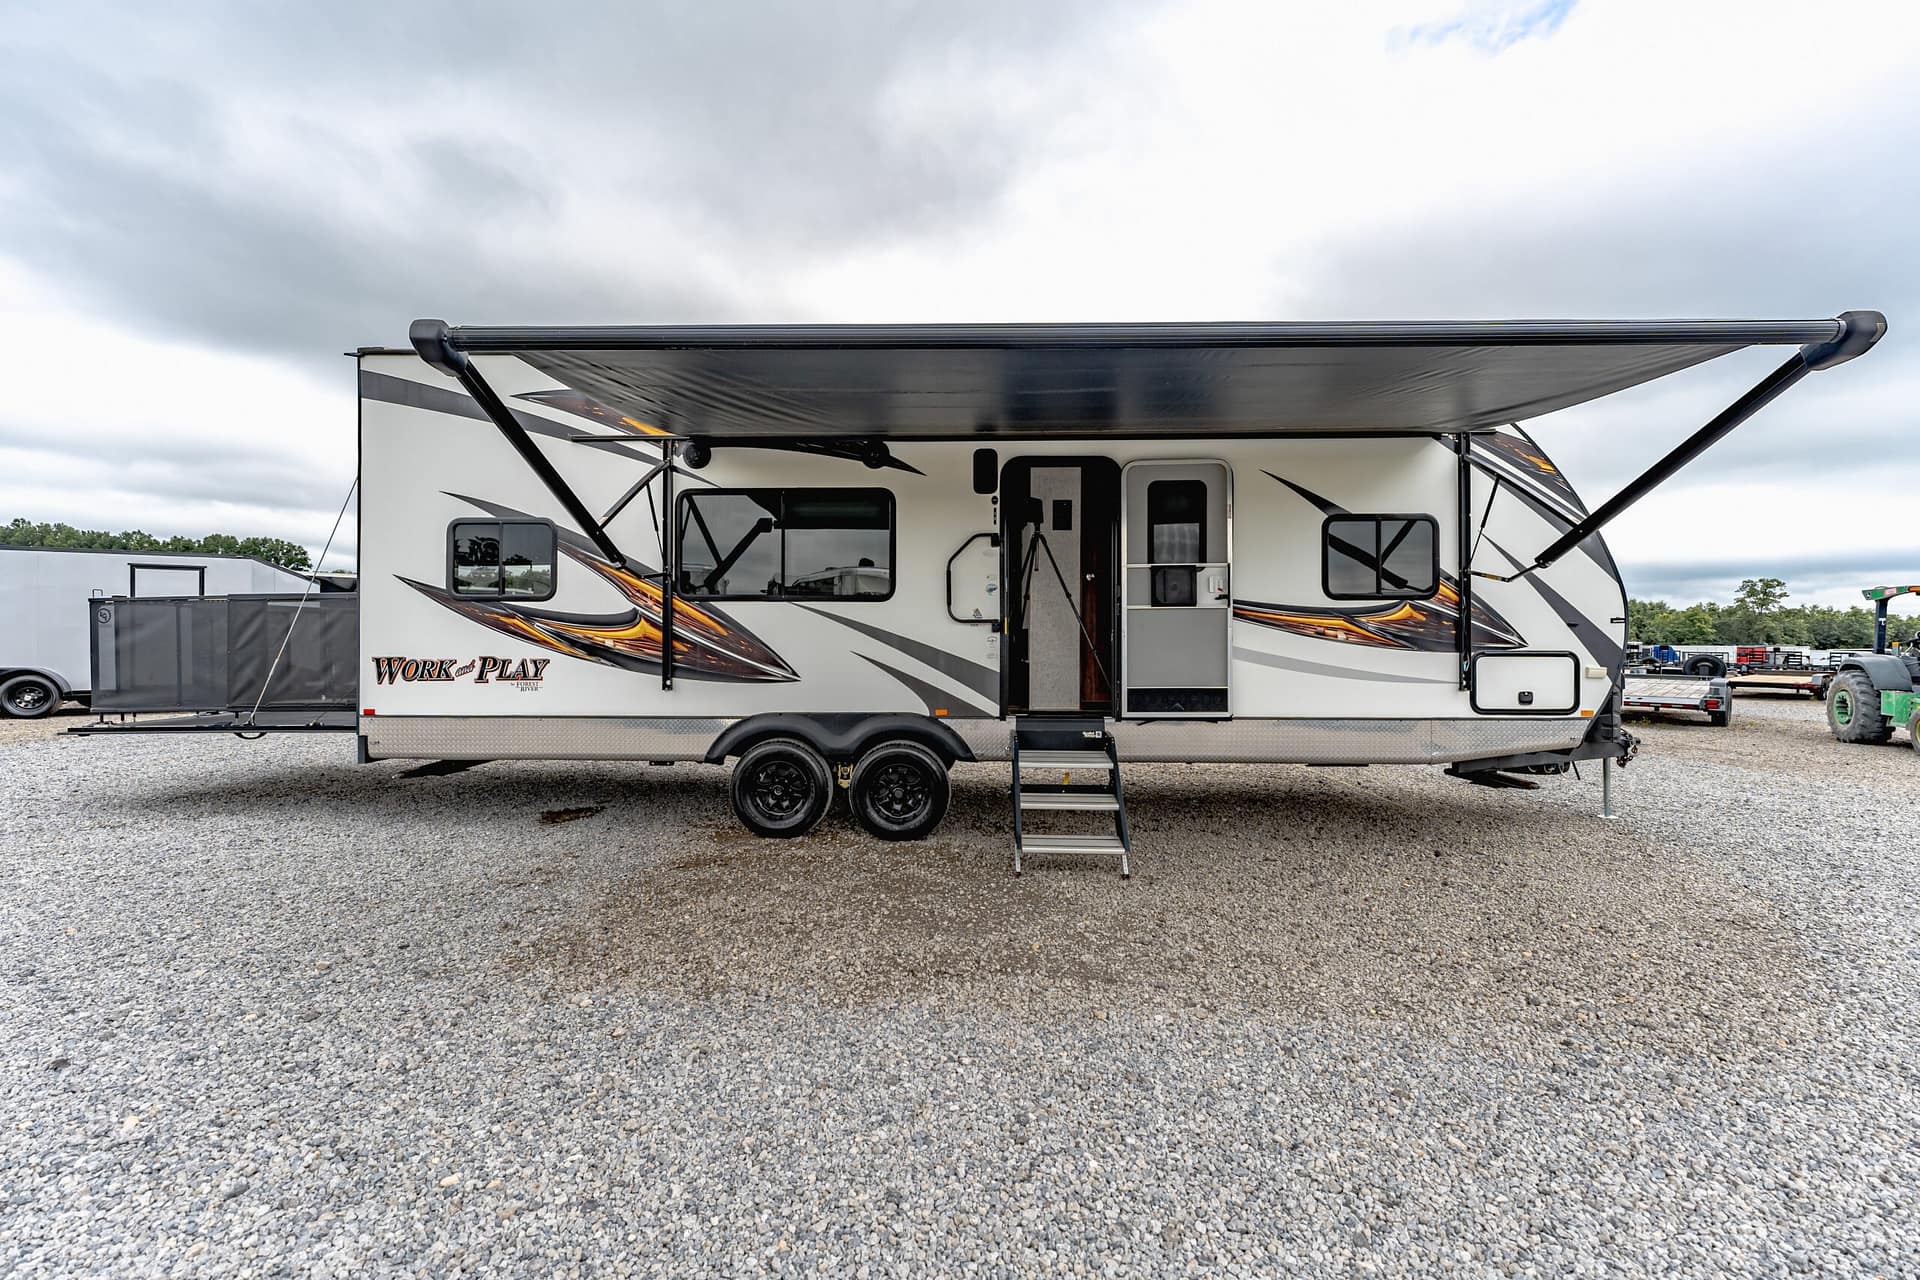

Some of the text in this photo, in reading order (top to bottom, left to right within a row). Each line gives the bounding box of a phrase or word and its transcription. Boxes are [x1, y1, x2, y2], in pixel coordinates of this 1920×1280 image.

[372, 656, 550, 684] WORK and PLAY
